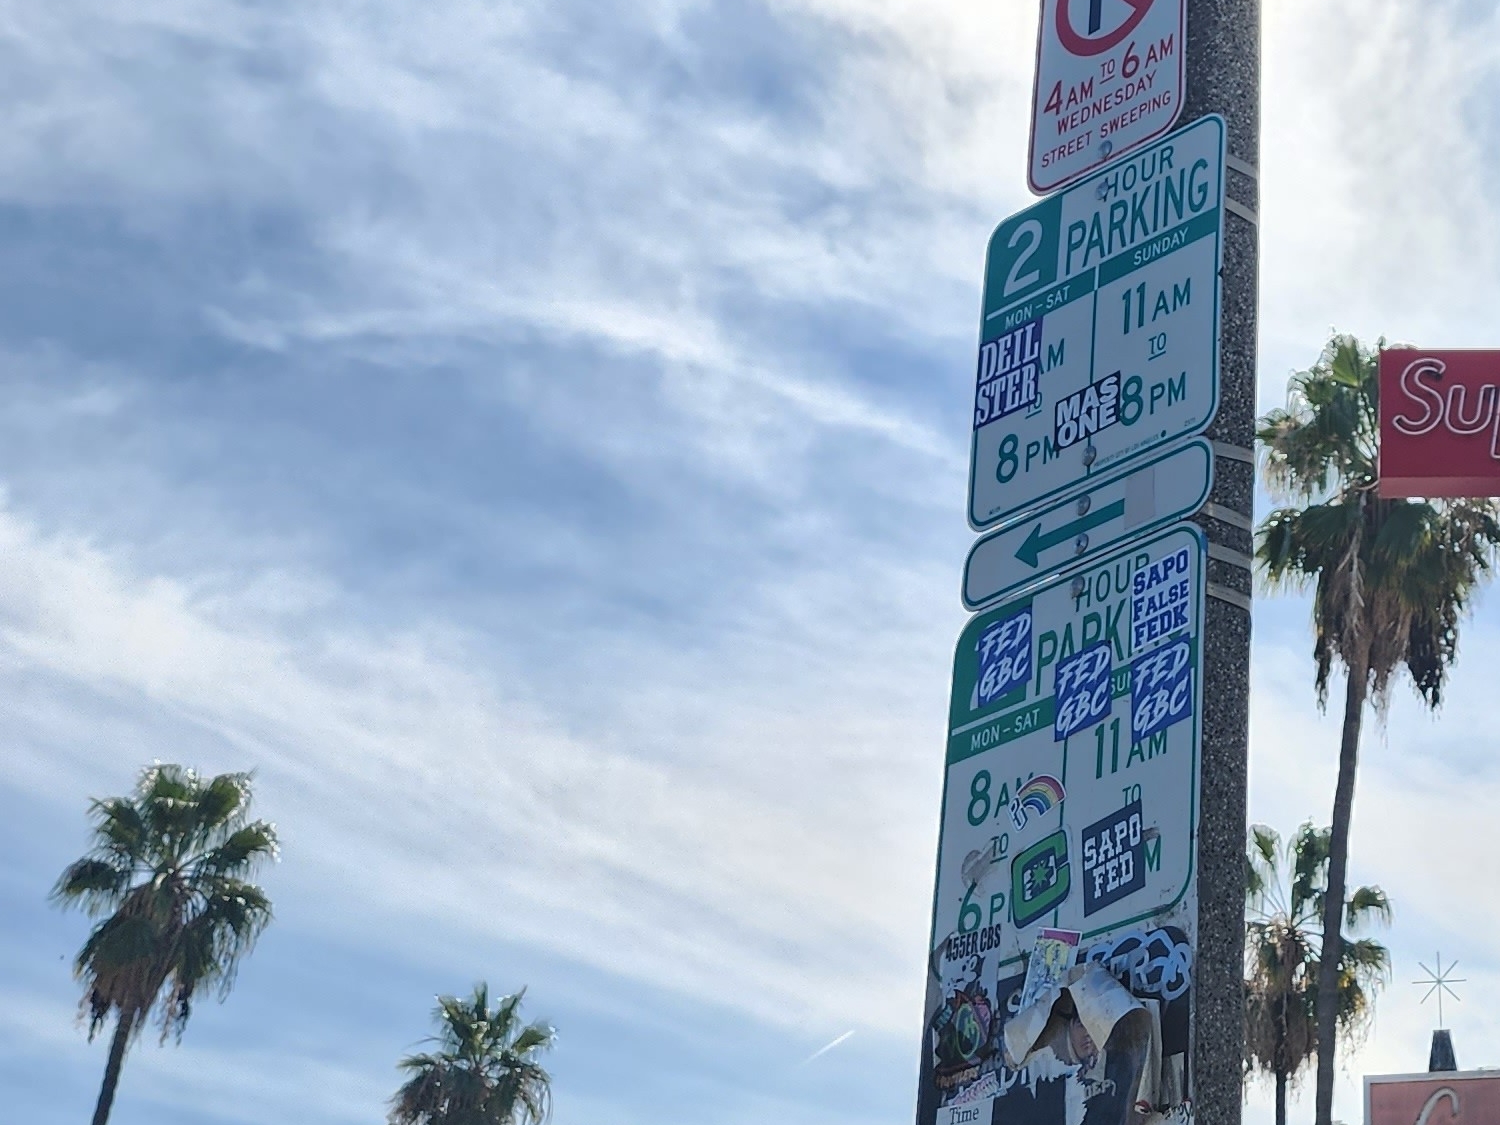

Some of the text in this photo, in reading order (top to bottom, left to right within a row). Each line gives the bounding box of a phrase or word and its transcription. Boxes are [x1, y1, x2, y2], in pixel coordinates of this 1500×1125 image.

[1101, 59, 1116, 78] TO
[1041, 90, 1171, 168] STREET SWEEPING
[1057, 69, 1157, 136] WEDNESDAY
[1101, 146, 1174, 202] HOUR
[1003, 158, 1209, 298] 2 PARKING
[1133, 227, 1189, 266] SUNDAY
[979, 322, 1039, 385] DEIL
[1148, 332, 1167, 355] TO
[975, 363, 1036, 426] STER
[1057, 376, 1119, 427] MAS
[1057, 399, 1117, 448] ONE
[1133, 549, 1189, 596] SAPO
[1133, 578, 1189, 623] FALSE
[1134, 601, 1189, 649] FEDK
[981, 611, 1031, 666] FED
[979, 643, 1030, 702] GBC
[1058, 645, 1111, 700] FED
[1133, 641, 1190, 699] FED
[1056, 676, 1109, 737] GBC
[1133, 674, 1189, 737] GBC
[1122, 783, 1142, 808] TO
[991, 832, 1009, 858] TO
[1083, 812, 1142, 872] SAPO
[1092, 850, 1134, 899] FED
[949, 1106, 980, 1125] Time
